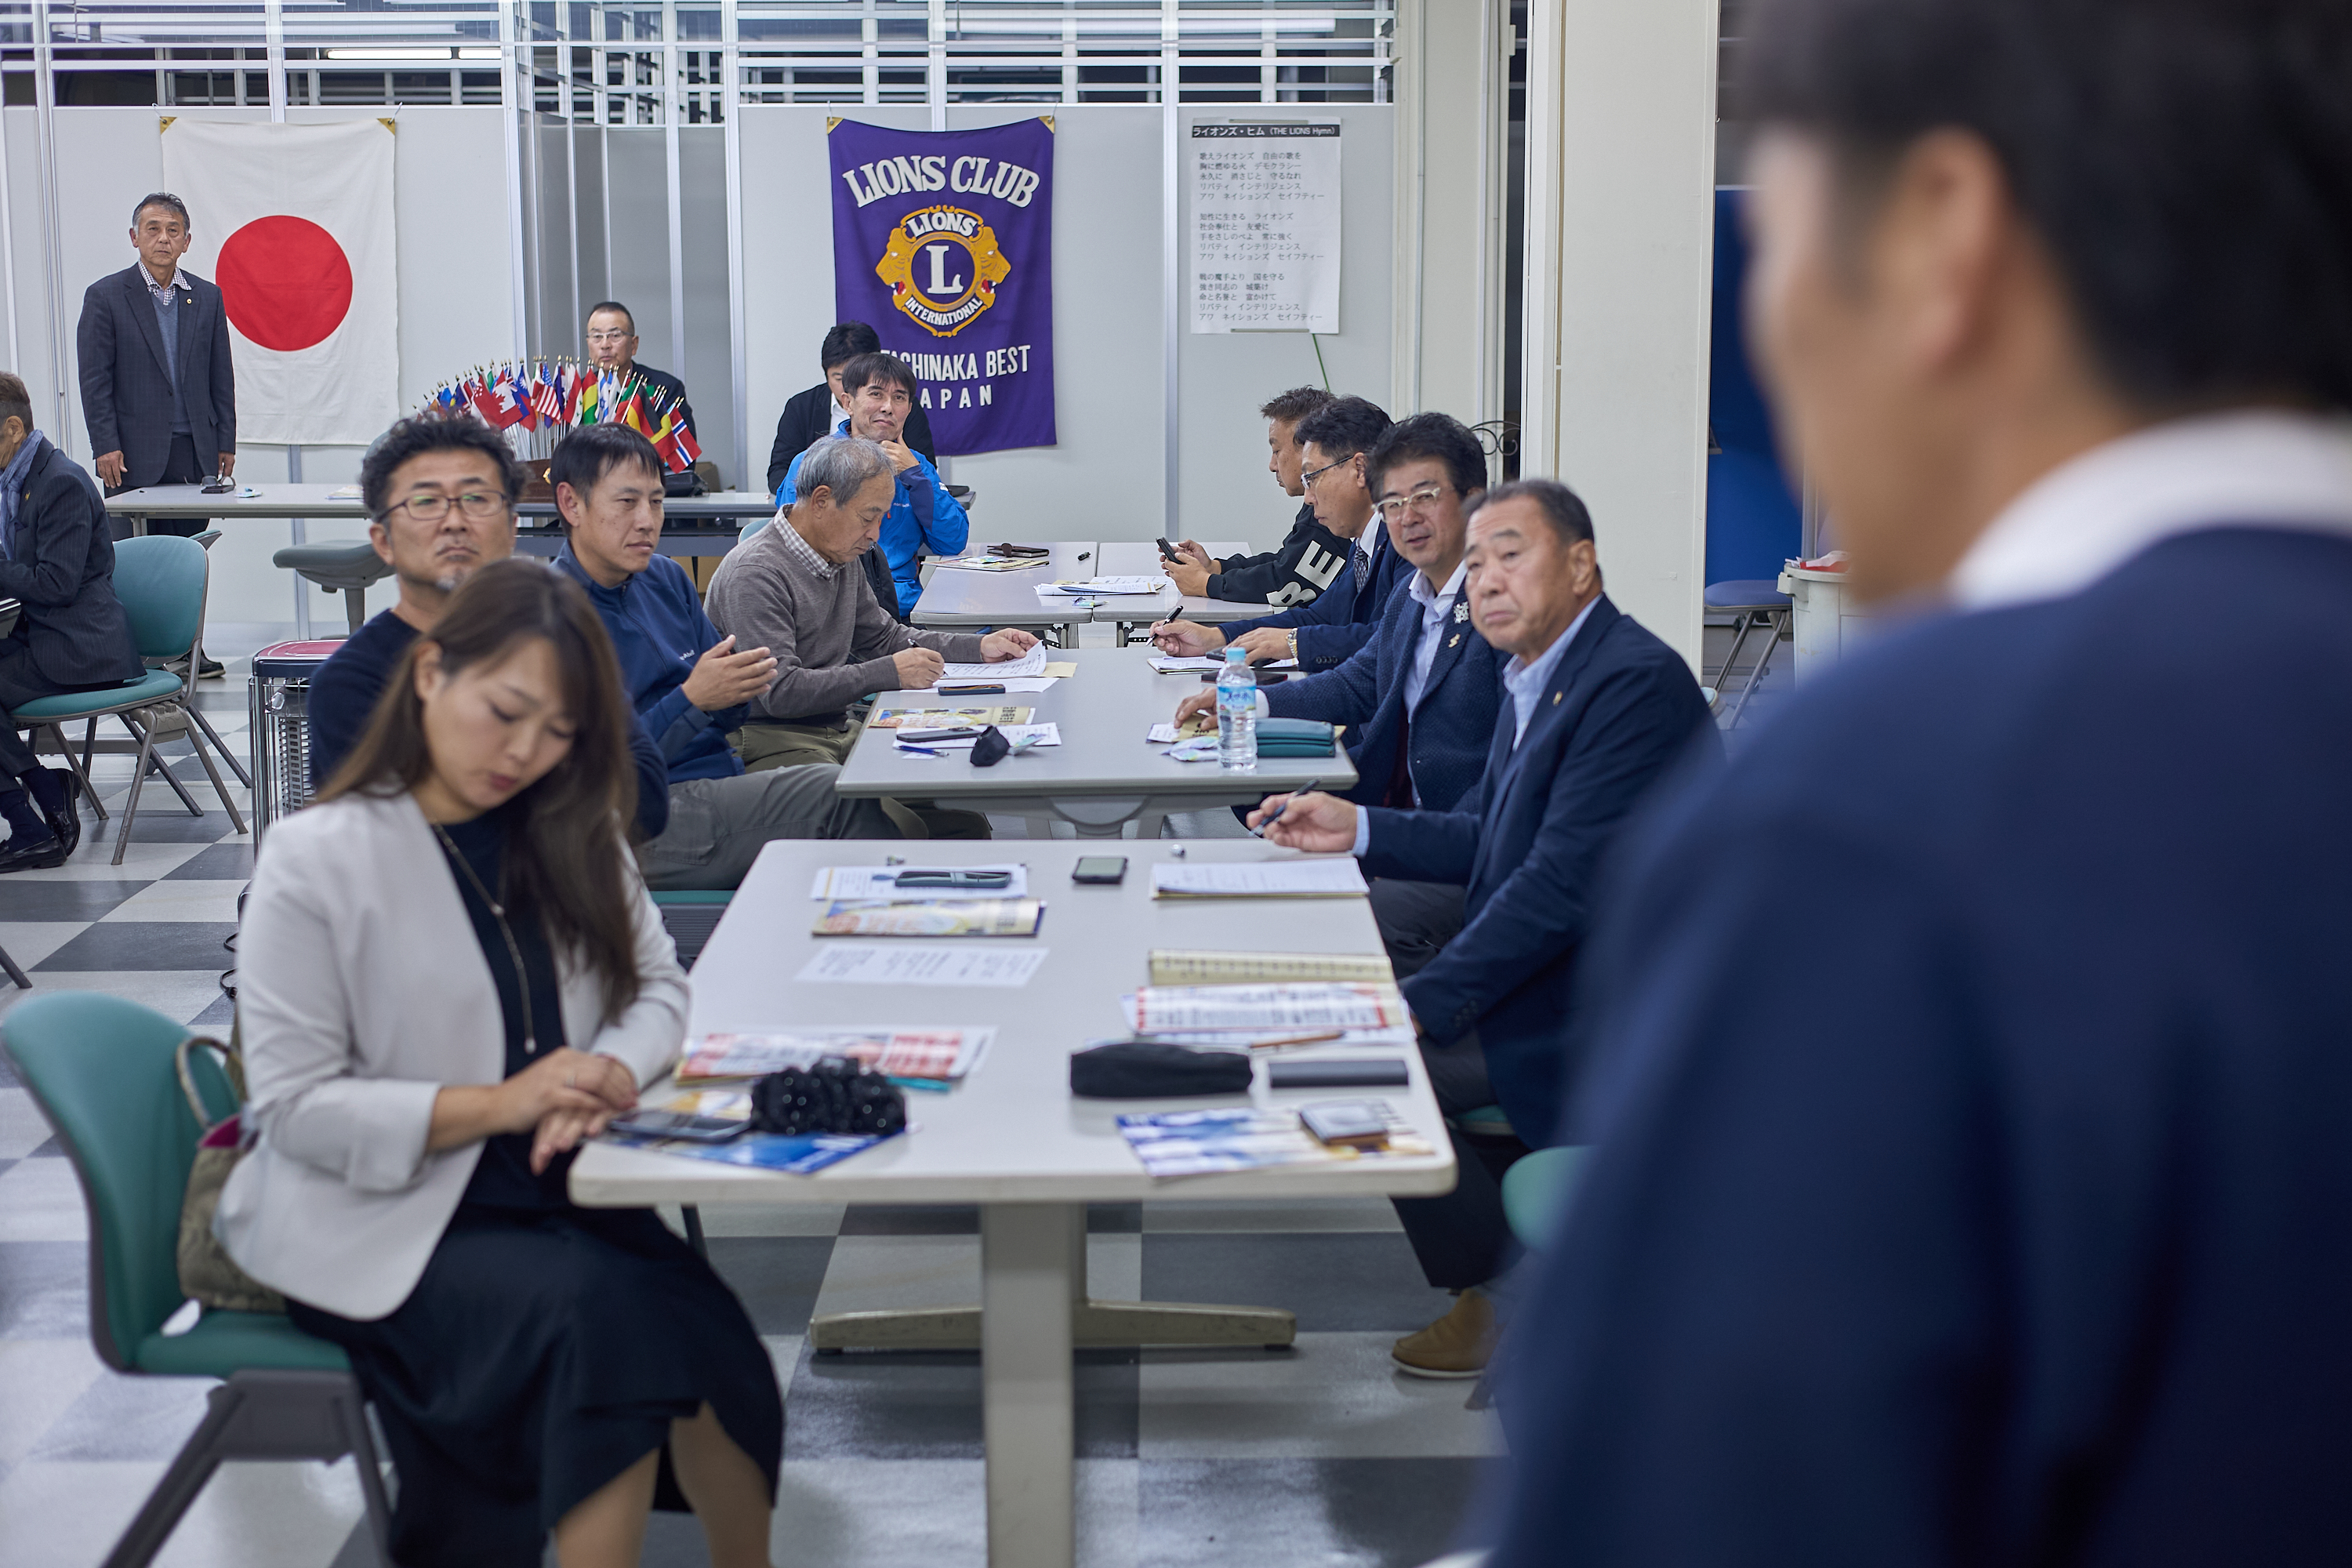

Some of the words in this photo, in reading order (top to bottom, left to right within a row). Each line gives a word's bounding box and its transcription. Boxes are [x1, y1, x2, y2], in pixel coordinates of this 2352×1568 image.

[1192, 126, 1265, 136] ライオンズ・ヒム
[842, 155, 946, 208] LIONS
[950, 156, 1040, 208] CLUB
[906, 212, 978, 237] LIONS
[926, 245, 964, 294] L
[905, 297, 983, 325] INTERNATIONAL
[986, 345, 1031, 377] BEST
[920, 384, 992, 409] APAN
